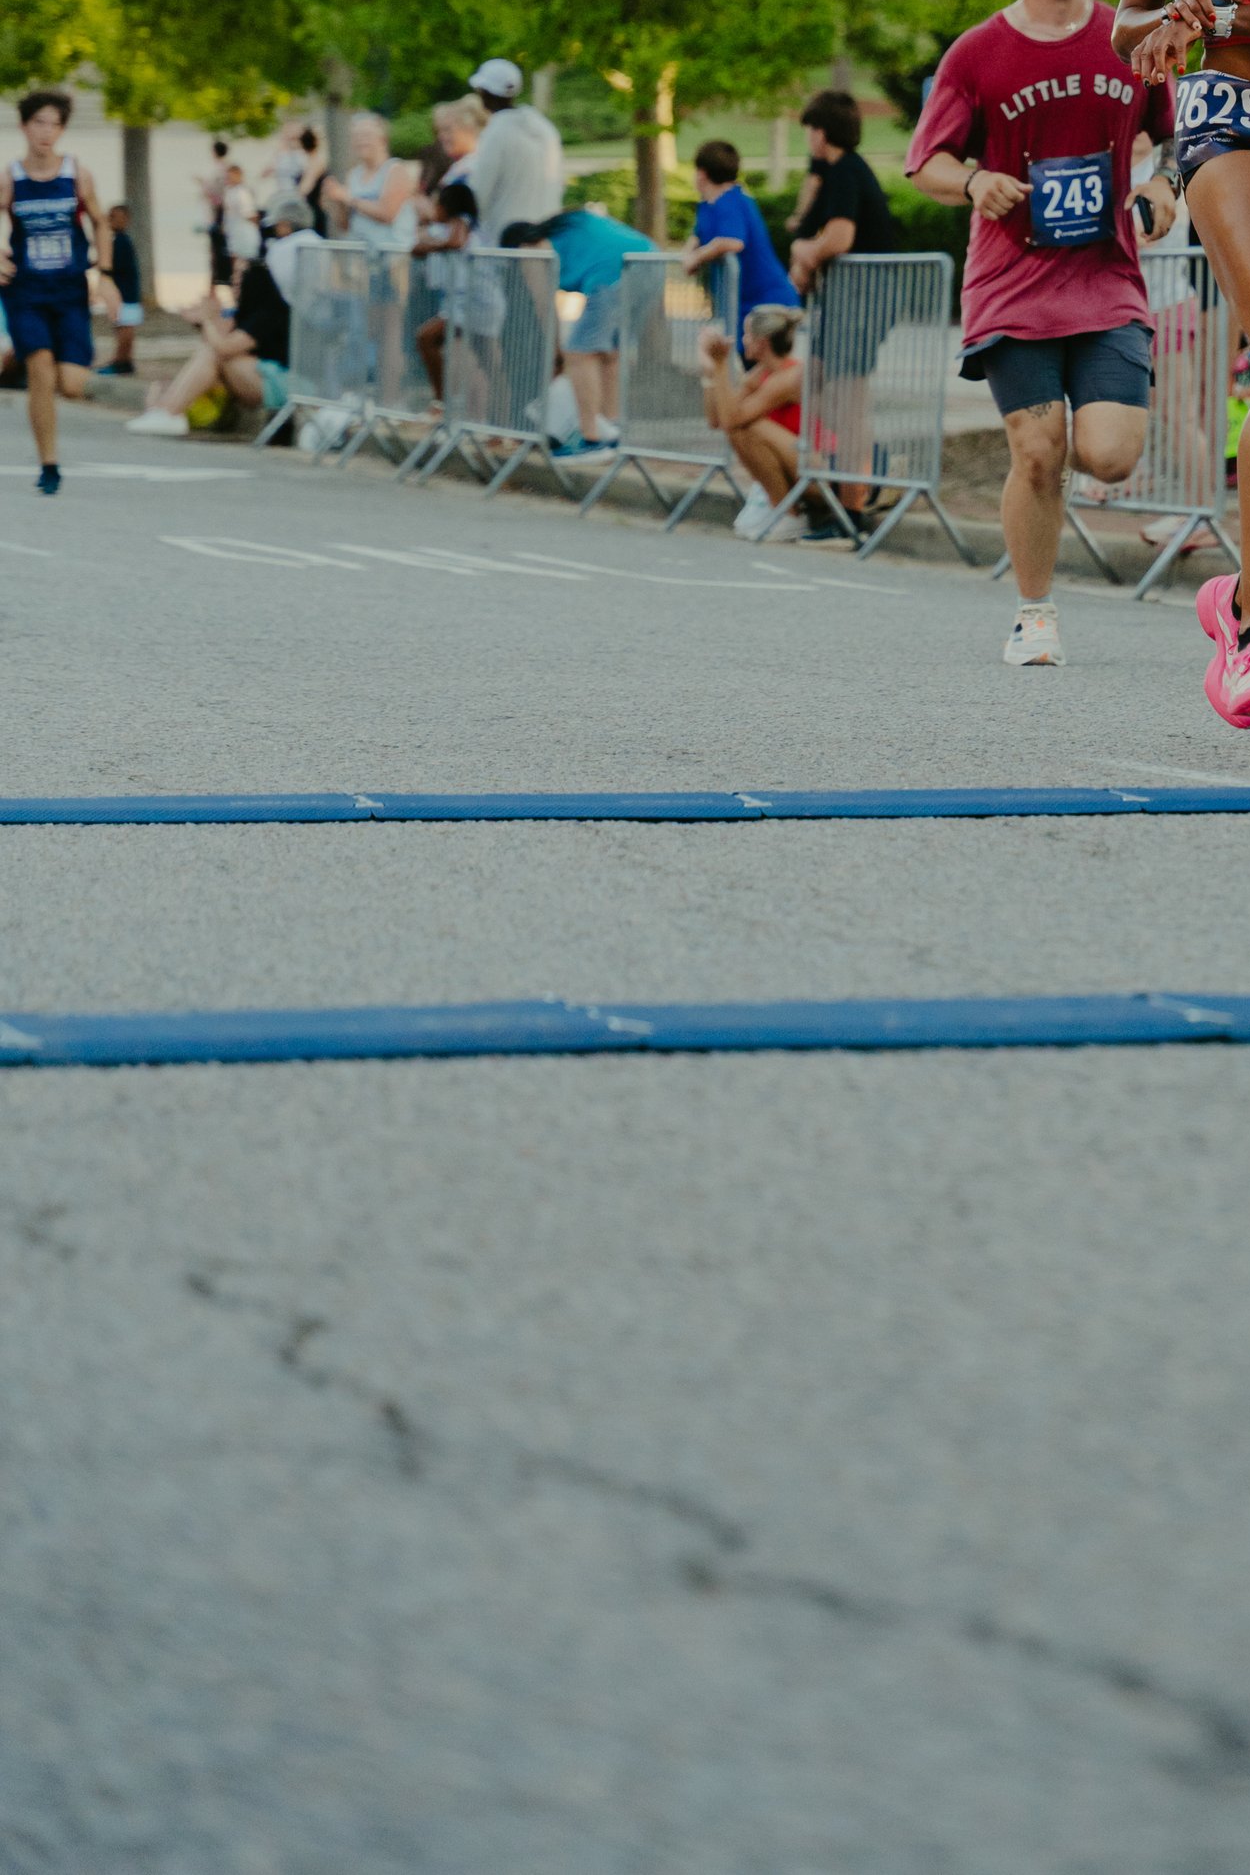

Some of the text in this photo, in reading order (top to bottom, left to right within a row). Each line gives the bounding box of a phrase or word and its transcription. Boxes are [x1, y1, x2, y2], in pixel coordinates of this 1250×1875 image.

[1000, 74, 1134, 121] LITTLE 500
[1042, 175, 1104, 219] 243
